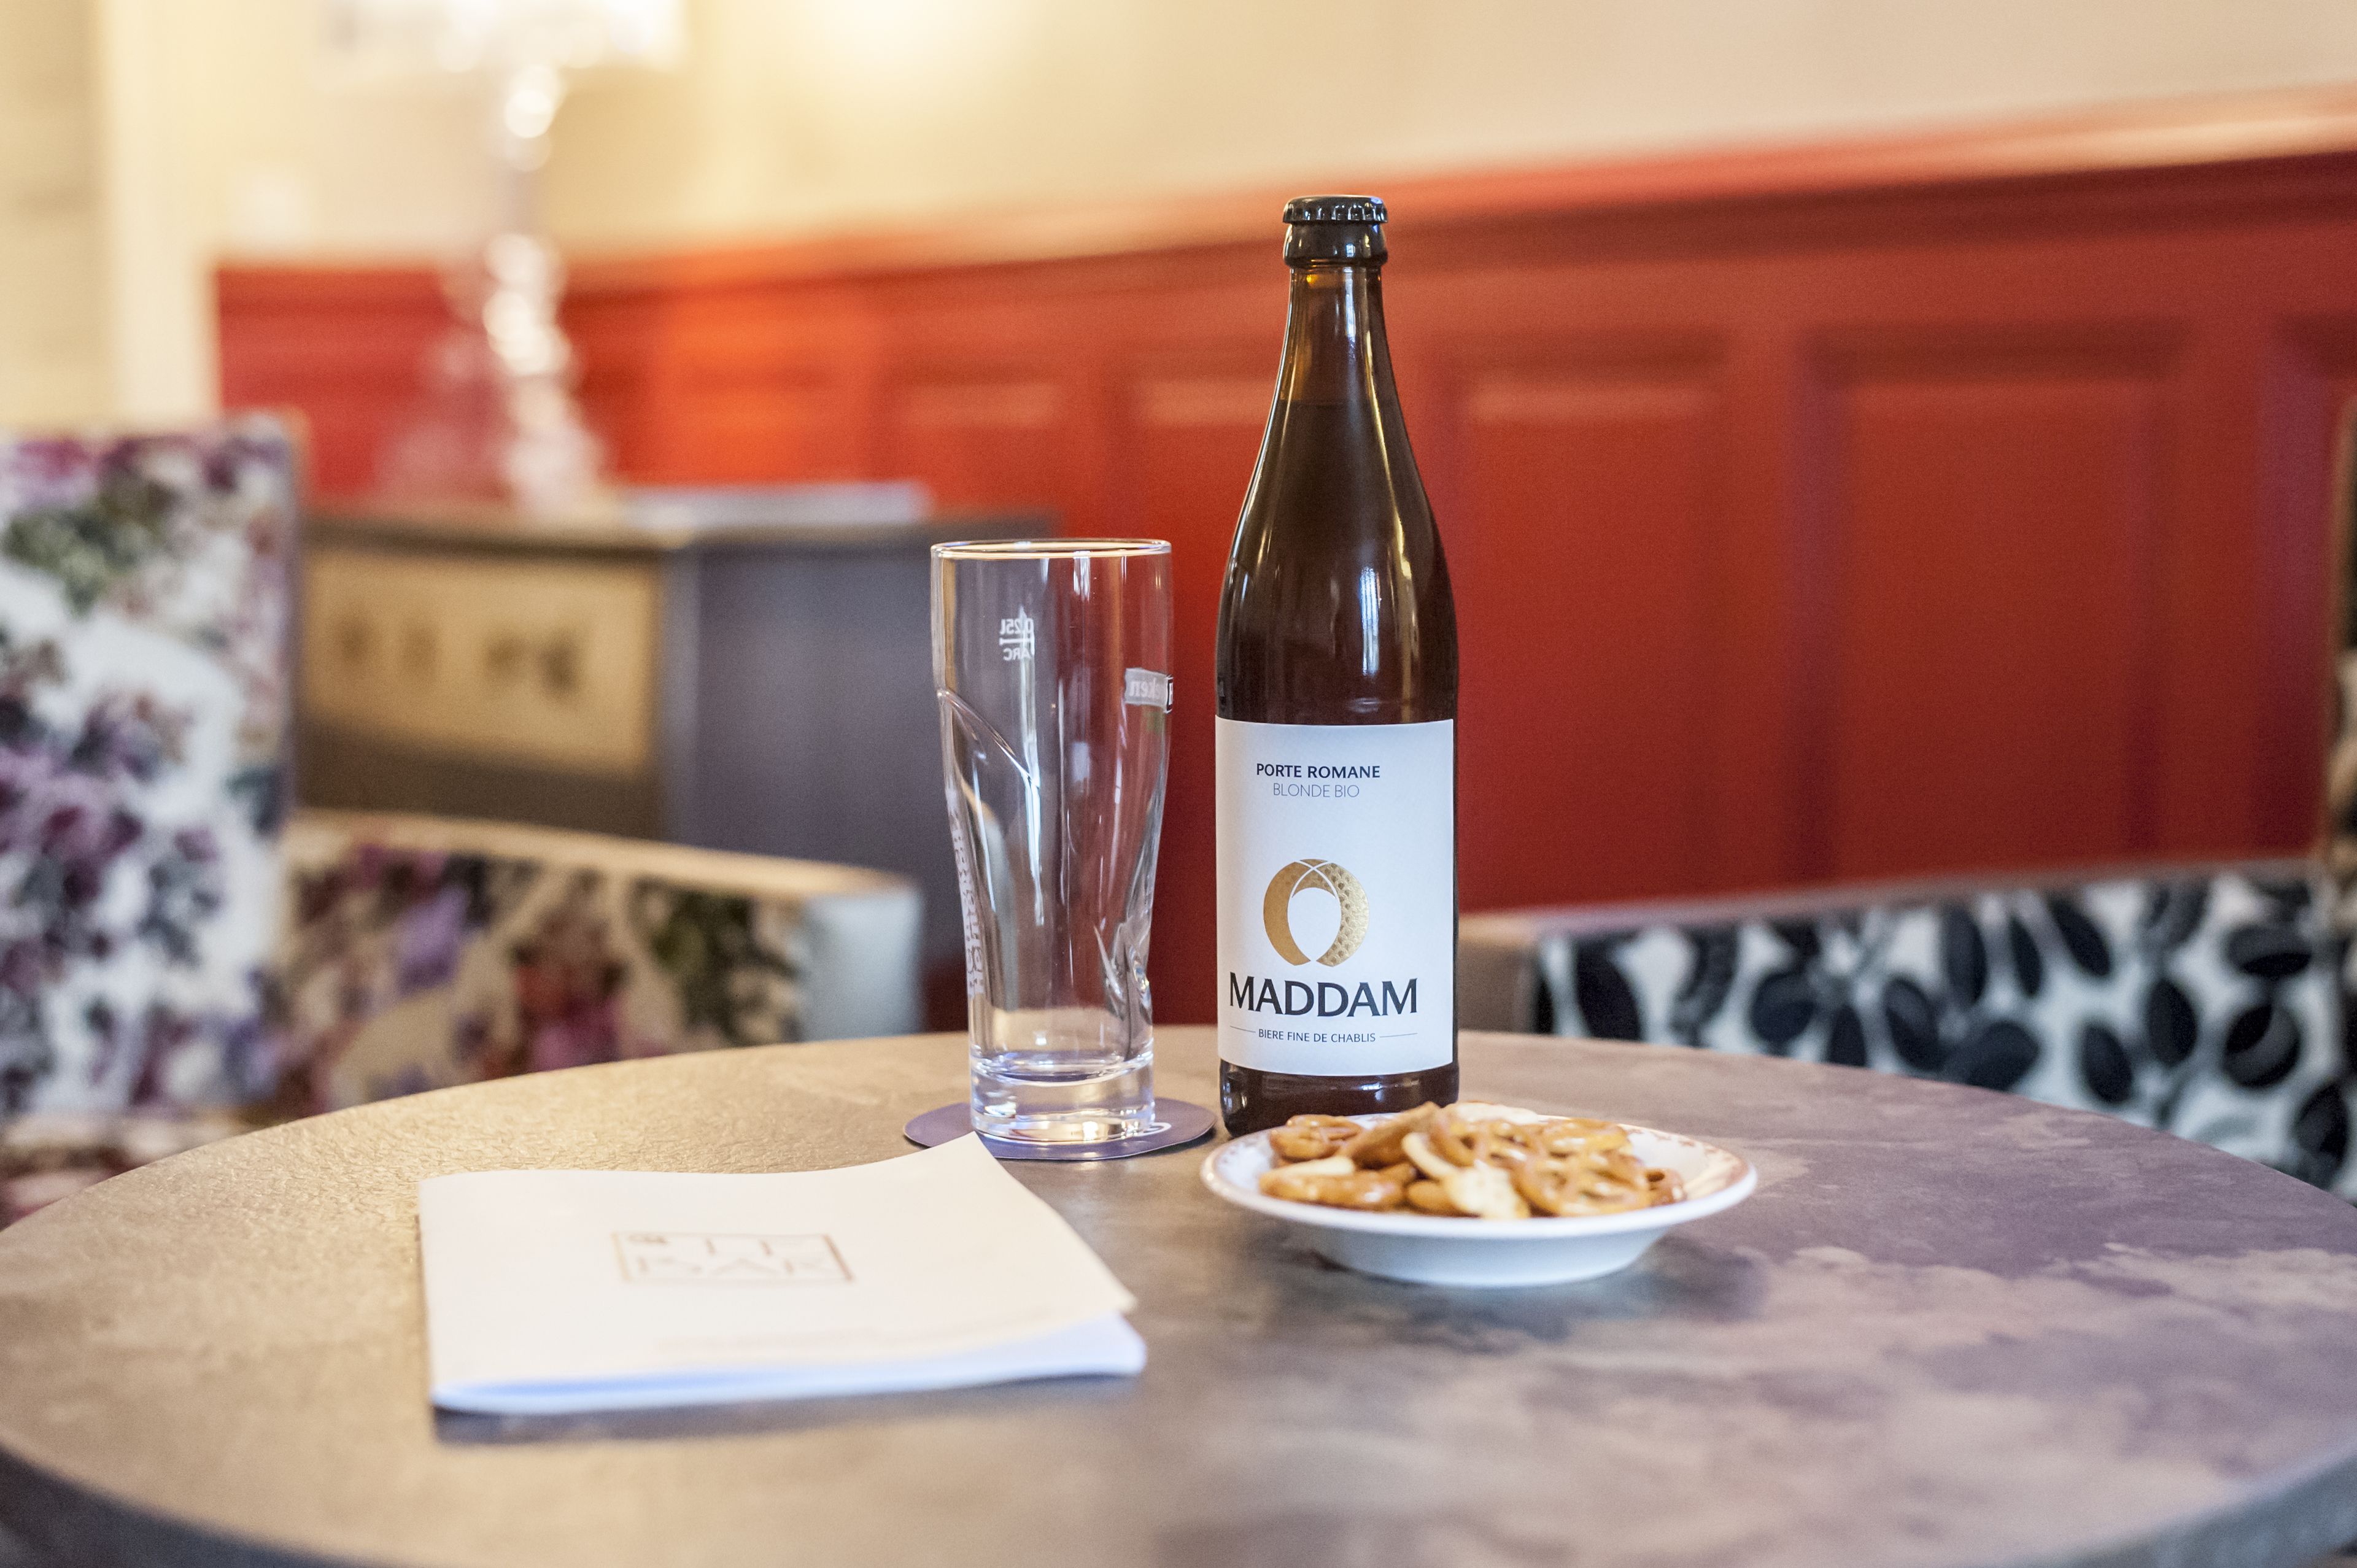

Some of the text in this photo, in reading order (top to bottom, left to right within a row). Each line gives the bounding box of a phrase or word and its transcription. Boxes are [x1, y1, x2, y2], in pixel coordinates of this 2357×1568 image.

[1256, 763, 1380, 779] PORTE ROMANE
[1273, 782, 1360, 798] BLONDE BIO
[1229, 971, 1417, 1018] MADDAM
[1258, 1029, 1376, 1043] BIERE FINE DE CHABLIS
